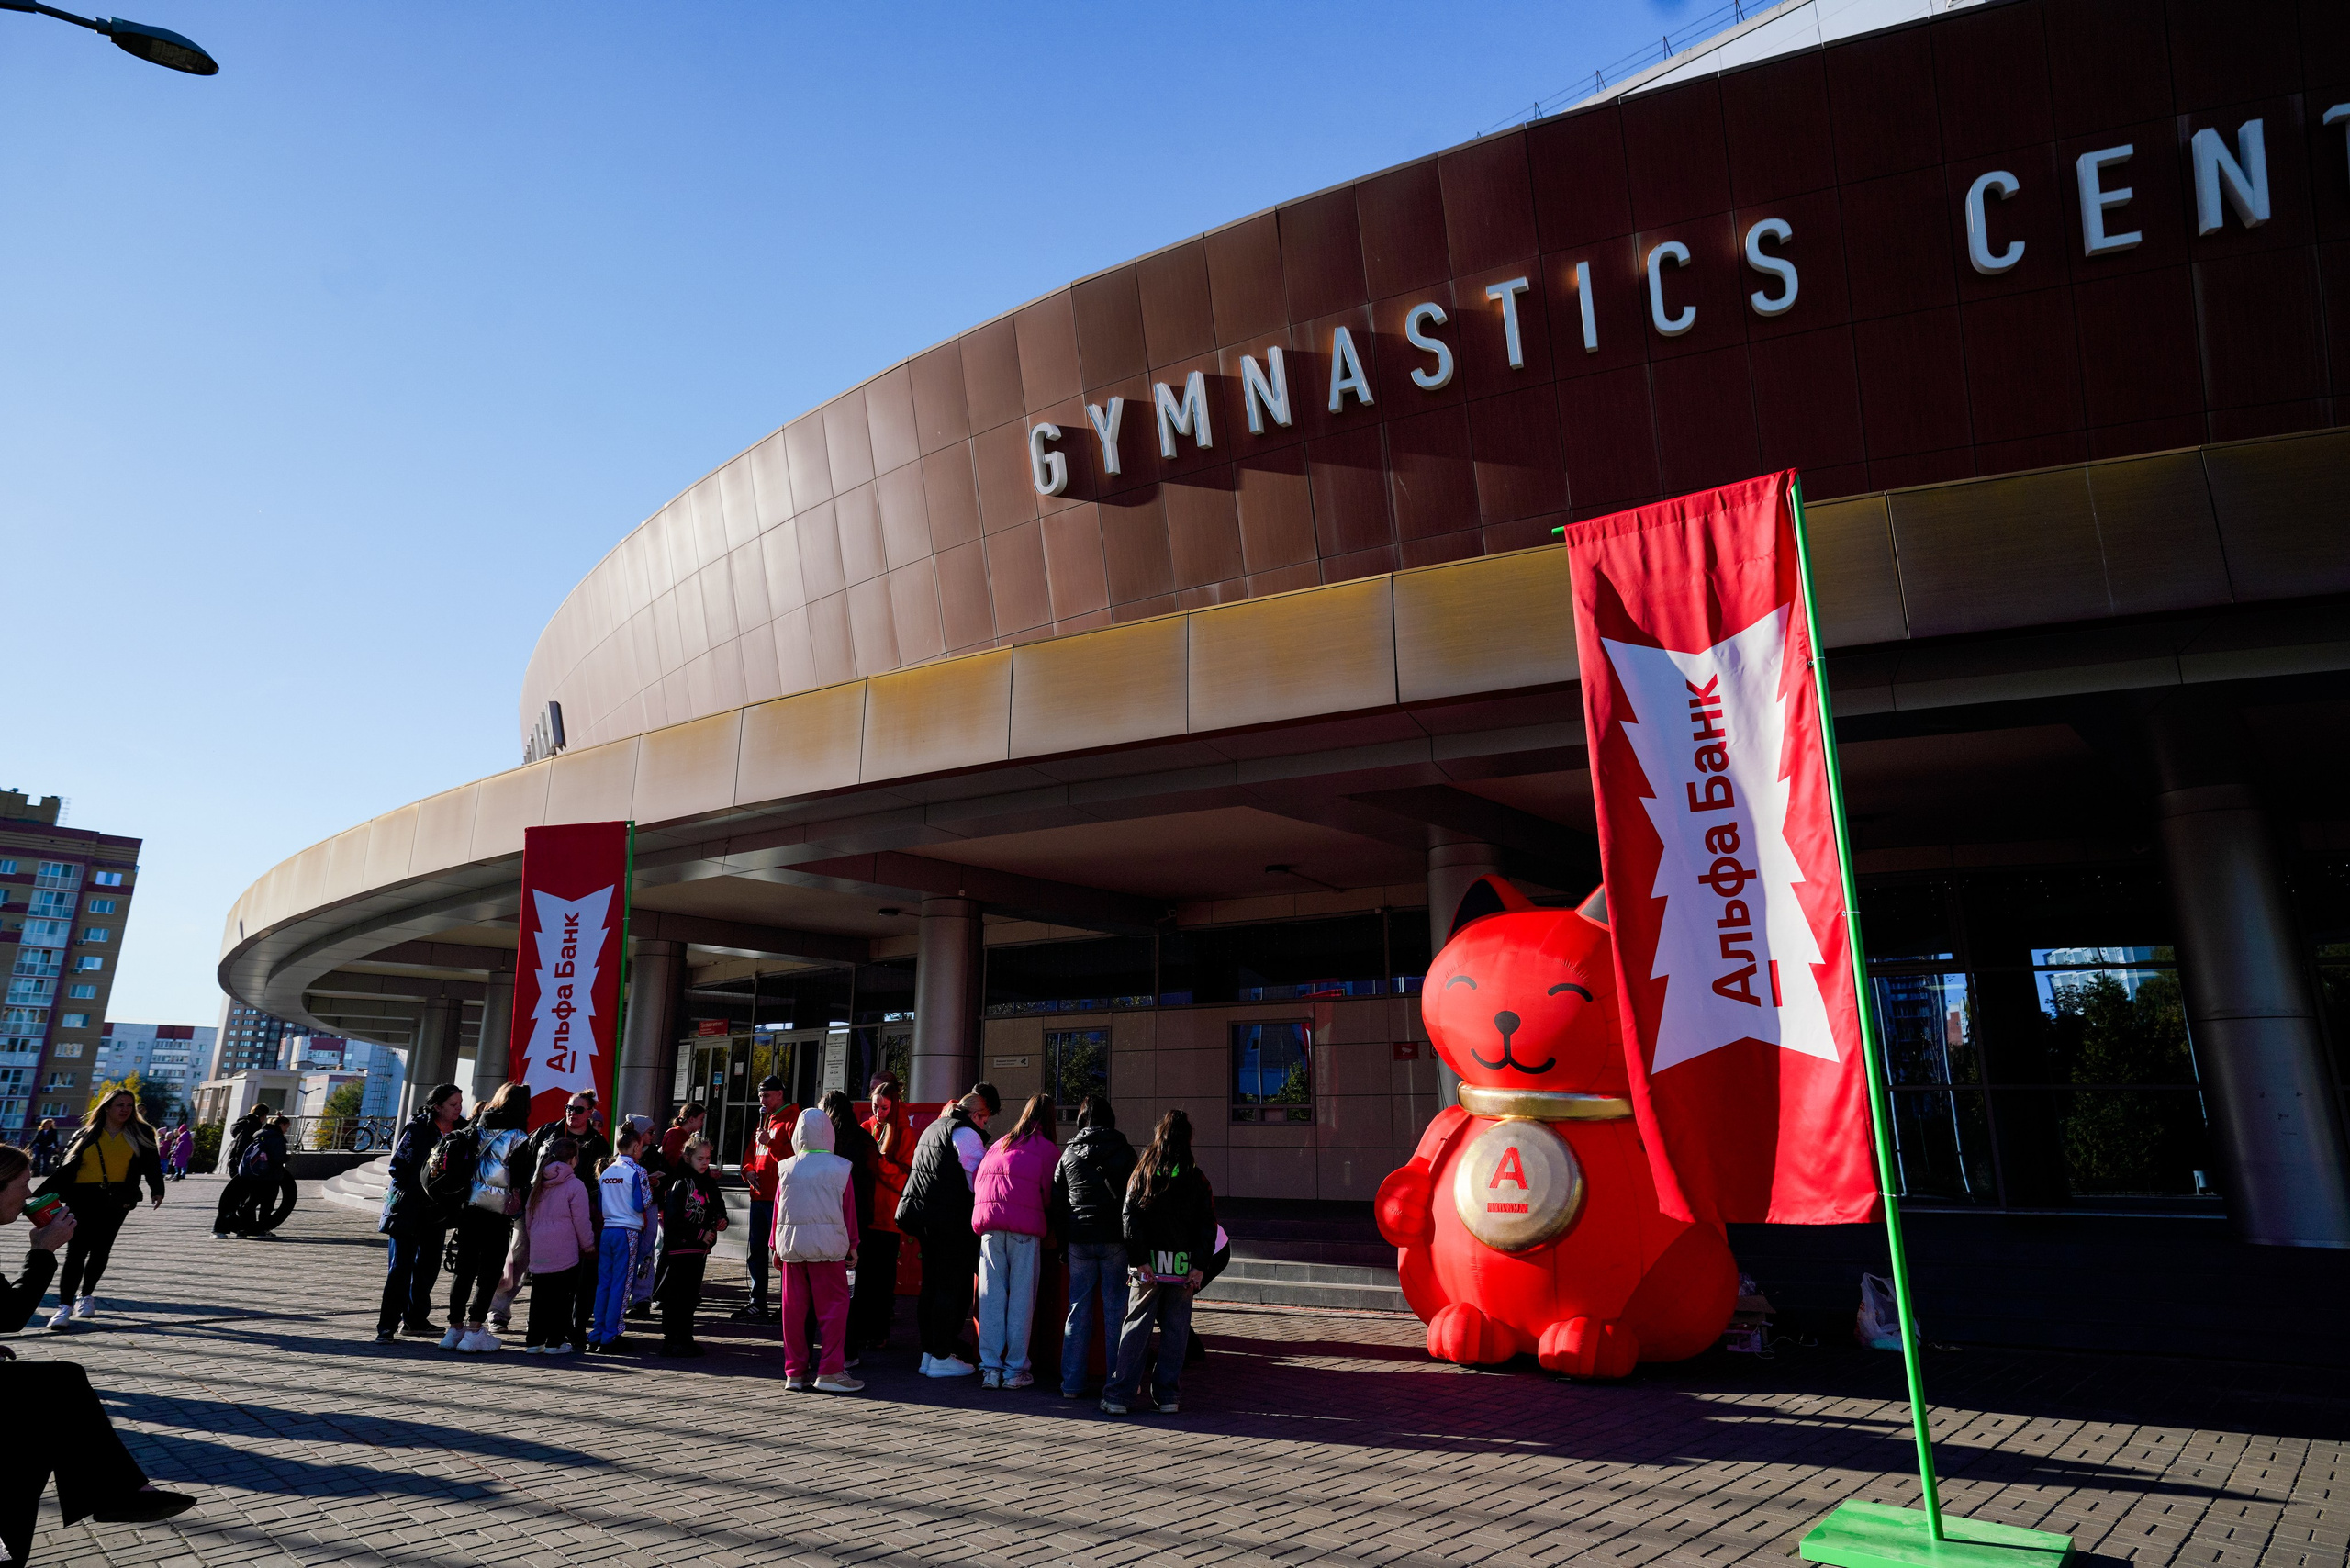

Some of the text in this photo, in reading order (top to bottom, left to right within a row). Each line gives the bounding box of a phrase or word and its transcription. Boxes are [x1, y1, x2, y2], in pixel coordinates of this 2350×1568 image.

[1027, 217, 1799, 497] GYMNASTICS
[1686, 673, 1762, 1008] Альфа Банк
[545, 911, 580, 1073] Альфа Банк
